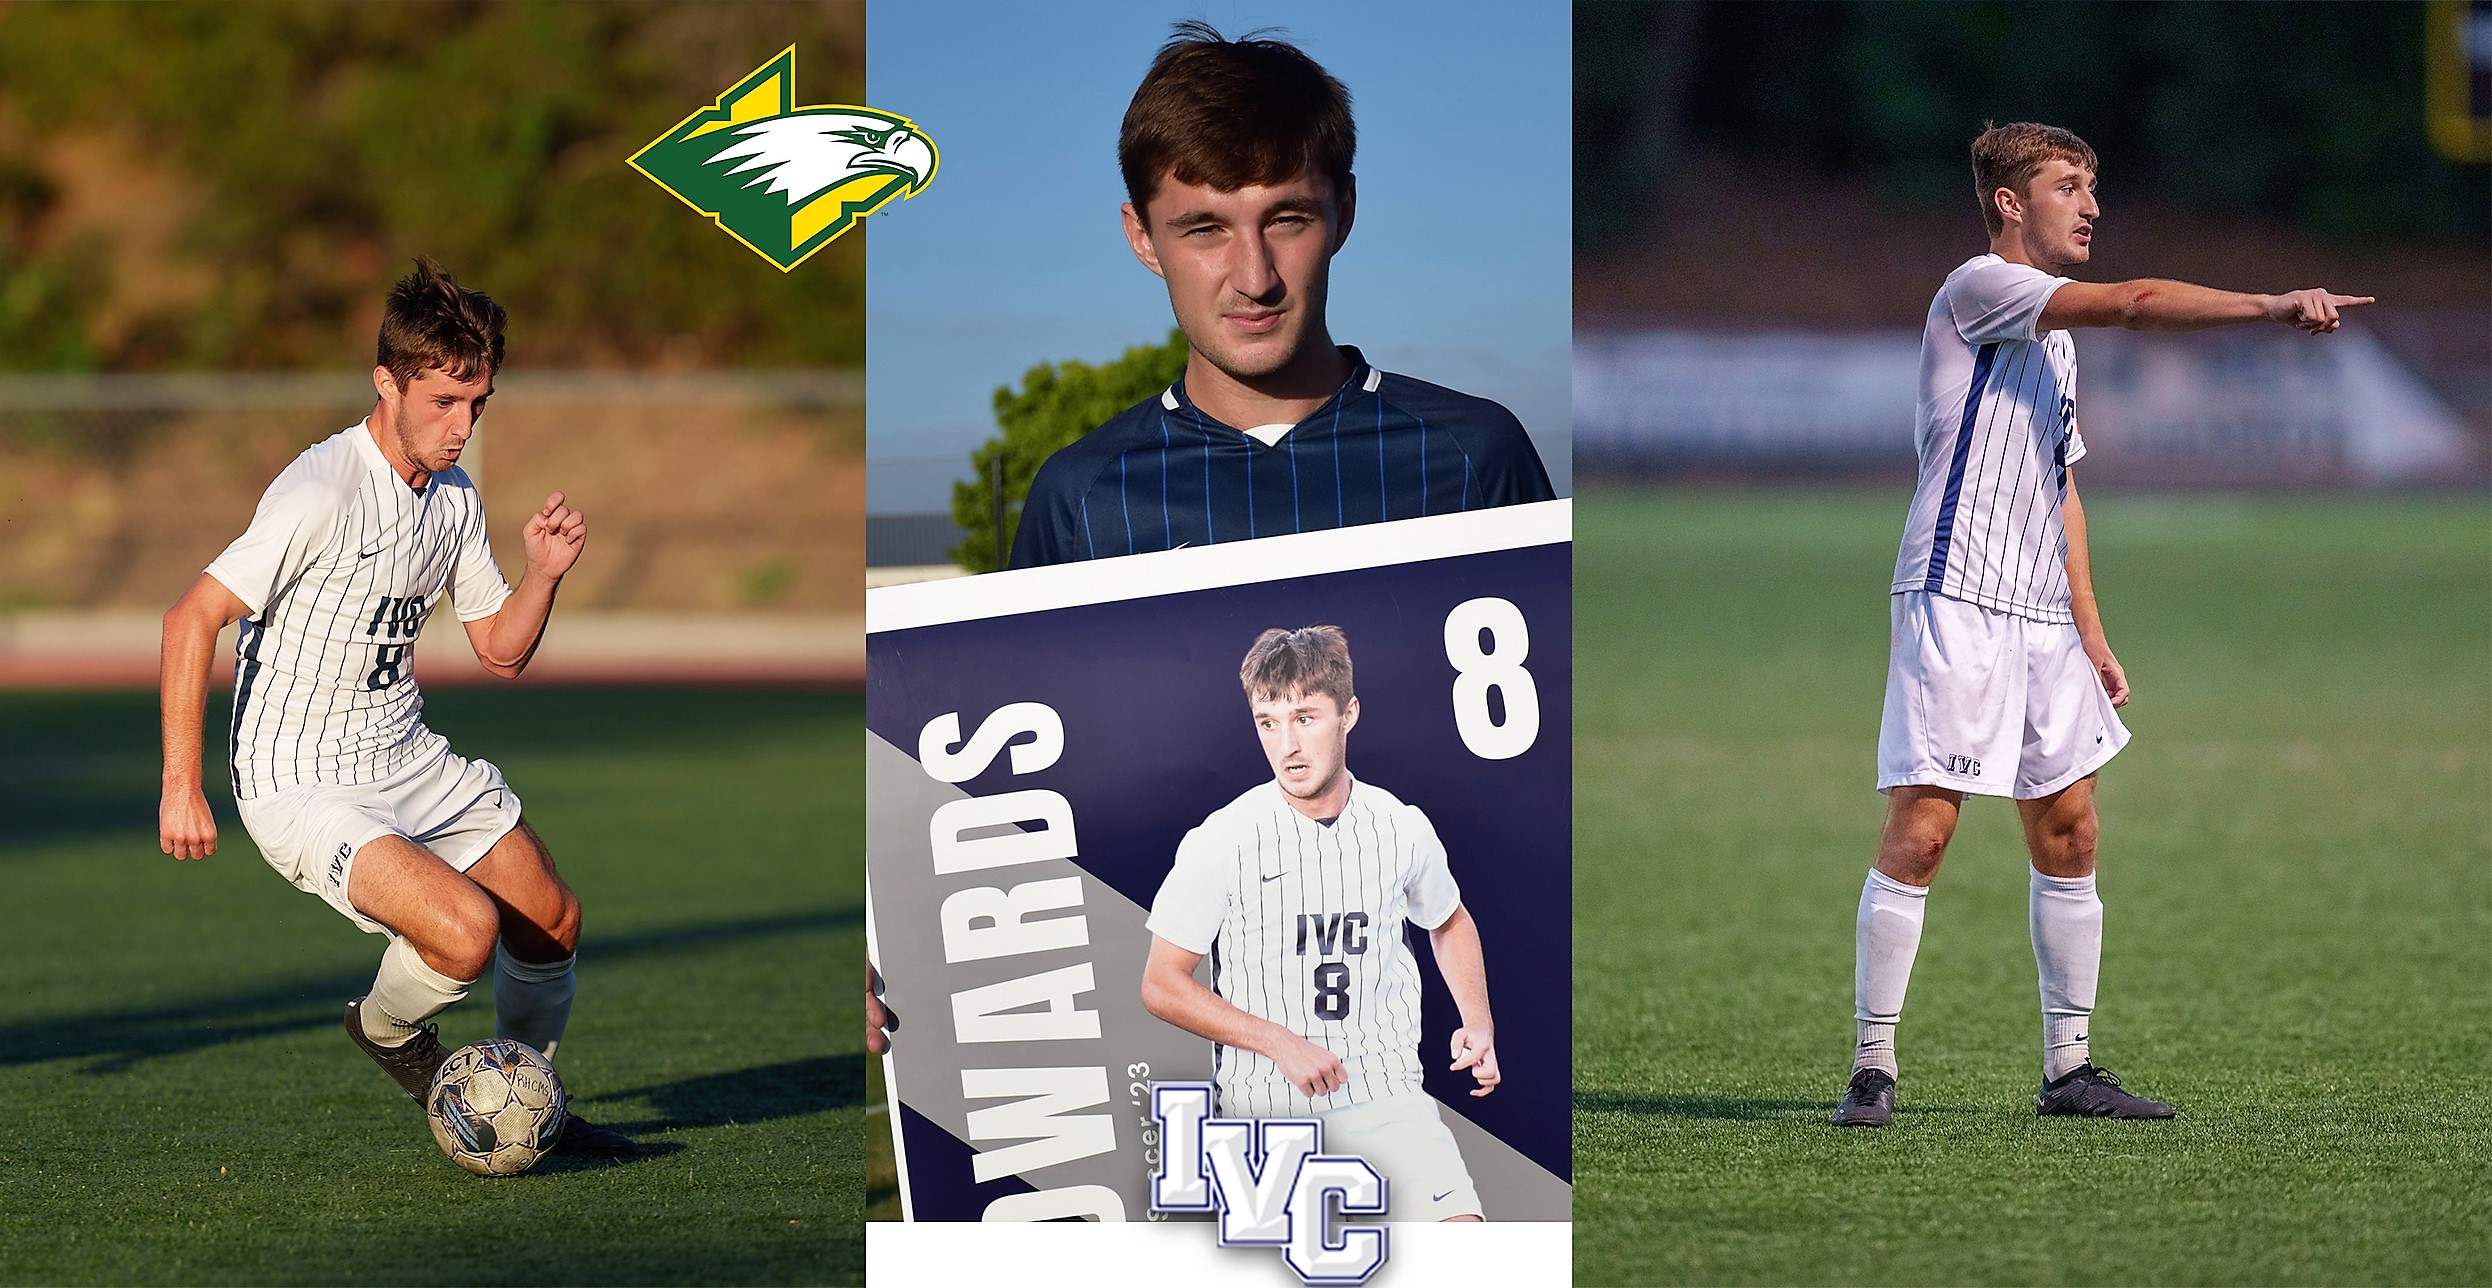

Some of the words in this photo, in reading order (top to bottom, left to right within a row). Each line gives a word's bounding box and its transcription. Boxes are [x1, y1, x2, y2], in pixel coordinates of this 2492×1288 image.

[367, 644, 404, 690] 8
[1443, 596, 1541, 760] 8
[1947, 753, 1981, 777] IVC
[327, 841, 352, 888] IVC
[1296, 911, 1369, 955] IVC
[1314, 962, 1350, 1021] 8
